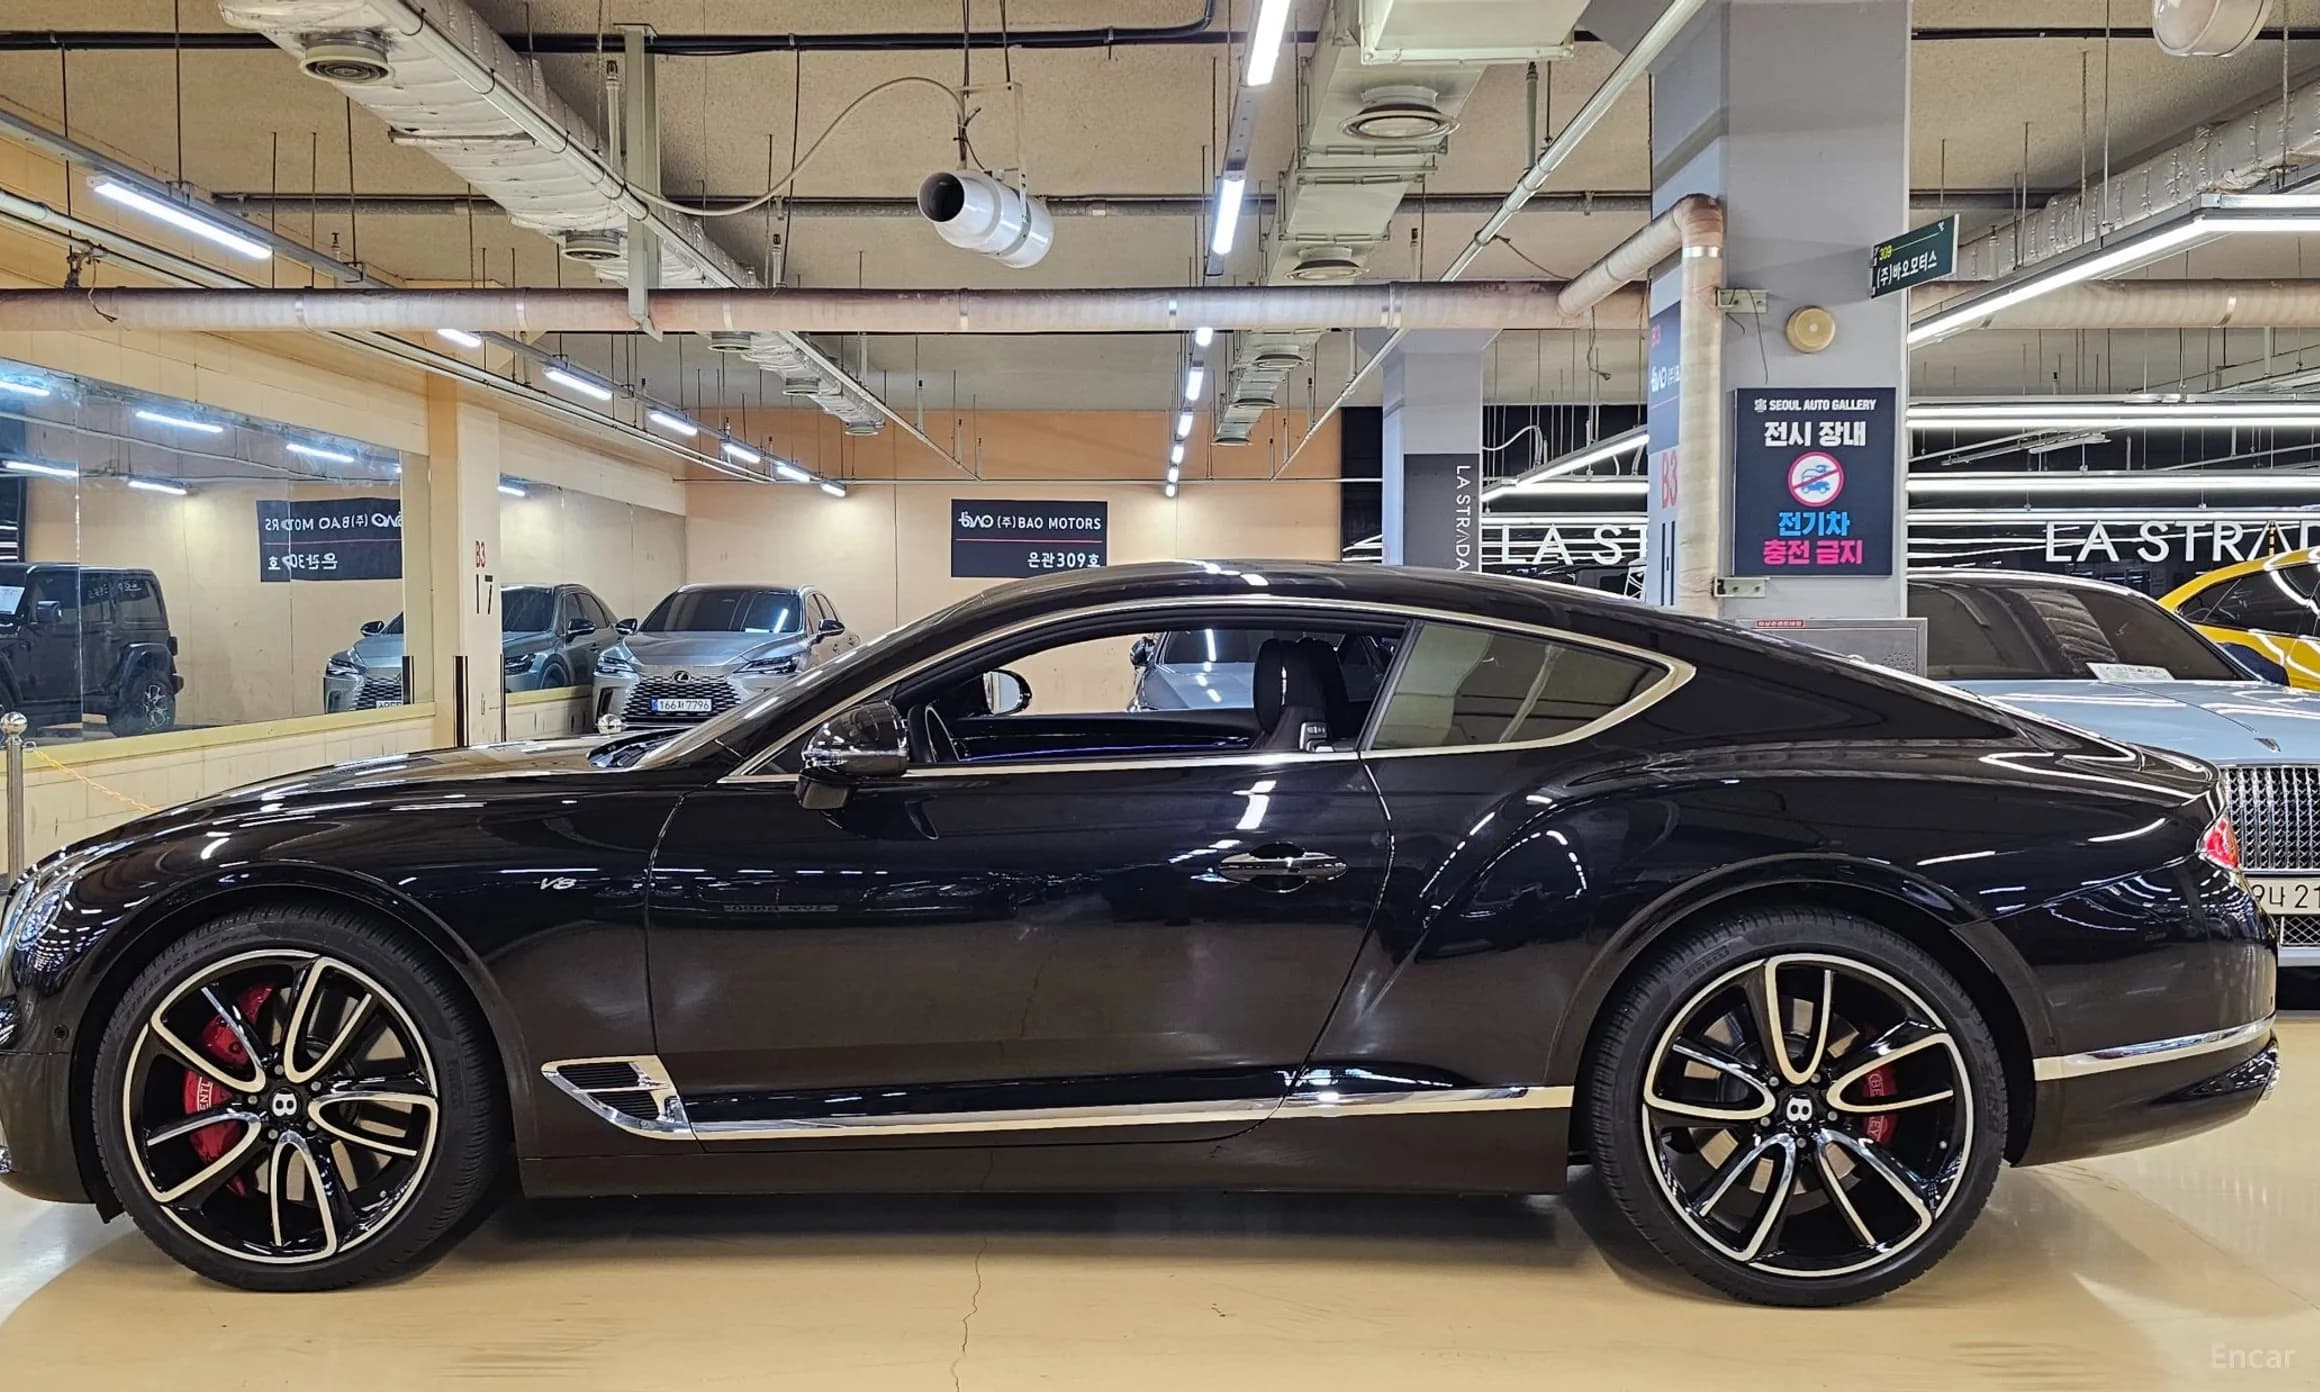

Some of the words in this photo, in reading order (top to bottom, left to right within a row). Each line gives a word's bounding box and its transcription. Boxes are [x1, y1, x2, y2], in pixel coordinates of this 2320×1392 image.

[1876, 250, 1937, 289] (주)바오모터스
[1768, 399, 1802, 411] SEOUL
[1803, 399, 1830, 411] AUTO
[1831, 399, 1877, 411] GALLERY
[1764, 421, 1812, 447] 전시
[1818, 421, 1867, 447] 장내
[1456, 465, 1472, 490] LA
[1661, 450, 1678, 509] B3
[1048, 517, 1102, 530] MOTORS
[1778, 511, 1851, 537] 전기차
[475, 540, 487, 568] B3
[1501, 523, 1574, 566] LA
[1763, 540, 1811, 565] 충전
[1816, 540, 1864, 565] 금지
[2044, 519, 2121, 563] LA
[1027, 551, 1101, 568] 은관309호
[475, 573, 494, 615] 17
[540, 876, 577, 890] V8
[199, 1081, 210, 1111] ENTL
